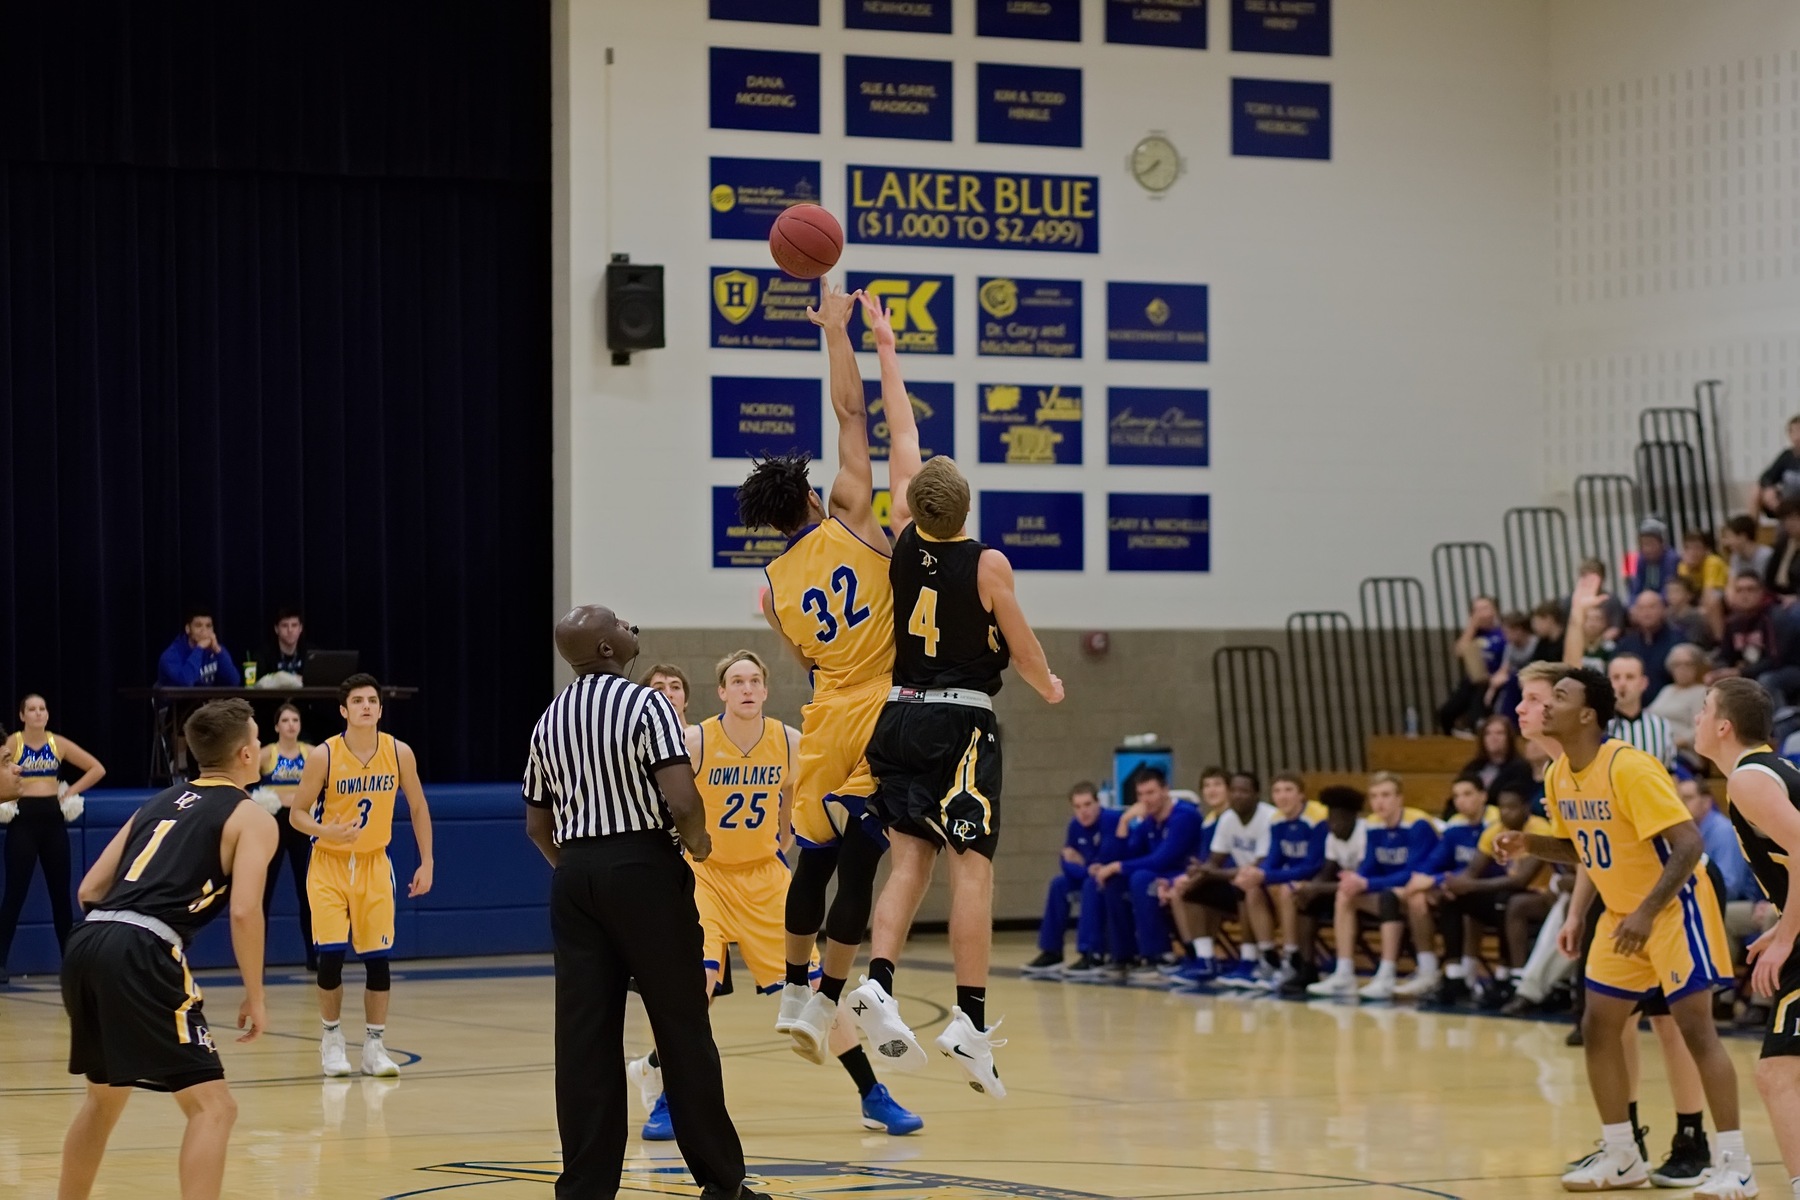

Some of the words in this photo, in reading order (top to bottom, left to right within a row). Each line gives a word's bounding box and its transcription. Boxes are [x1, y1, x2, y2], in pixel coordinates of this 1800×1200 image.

[746, 75, 784, 90] DANA
[852, 170, 984, 214] LAKER
[995, 177, 1093, 219] BLUE
[858, 212, 948, 240] ($1,000
[953, 215, 988, 241] TO
[996, 218, 1084, 248] $2,499)
[723, 282, 747, 307] H
[861, 279, 942, 331] GK
[1006, 322, 1038, 341] Cory
[1041, 322, 1066, 337] and
[740, 403, 794, 417] NORTON
[739, 420, 795, 435] KNUTSEN
[1002, 533, 1062, 547] WILLIAMS
[801, 563, 871, 644] 32
[908, 585, 940, 658] 4
[337, 777, 361, 795] IOWA
[362, 775, 395, 792] LAKES
[708, 766, 740, 786] IOWA
[742, 765, 782, 785] LAKES
[352, 798, 372, 829] 3
[719, 792, 768, 829] 25
[1580, 800, 1612, 820] LAKES
[124, 819, 177, 882] 1
[1577, 829, 1612, 869] 30
